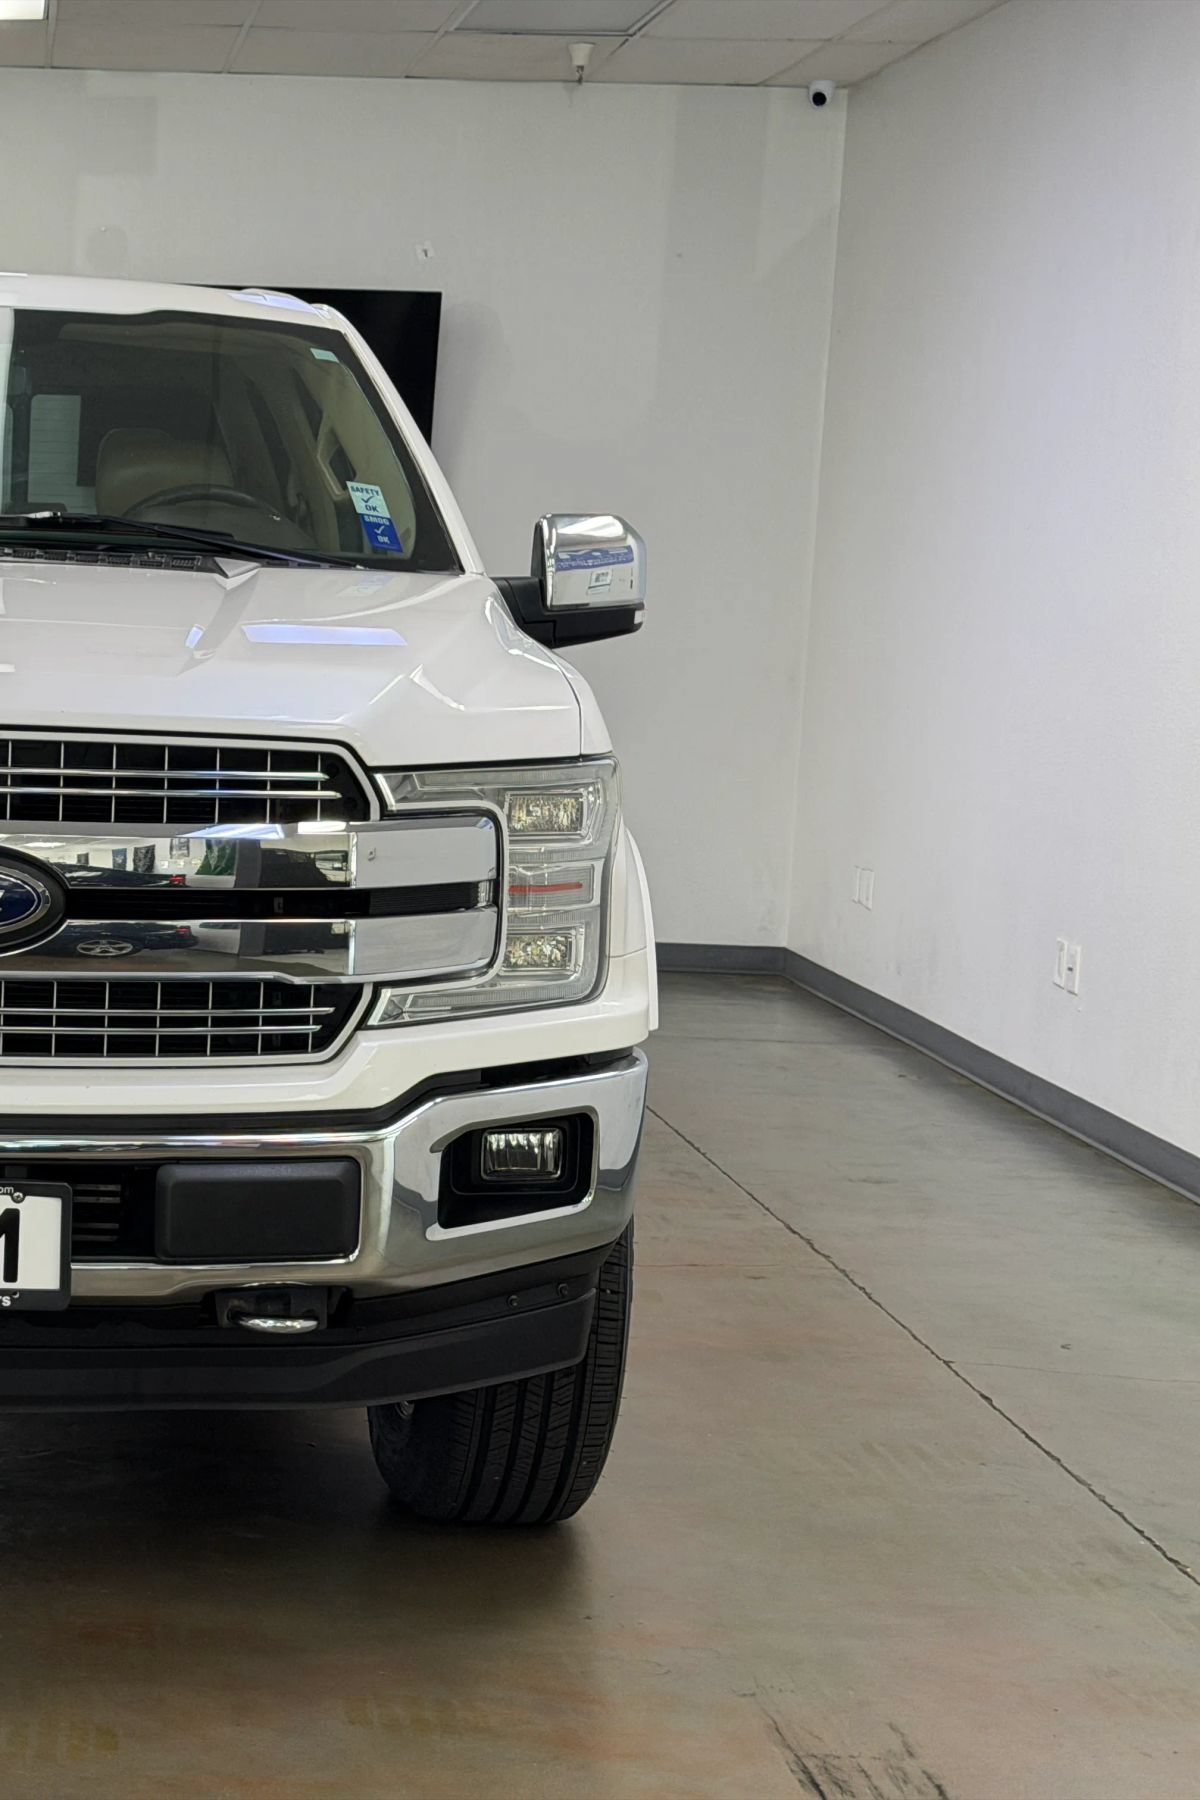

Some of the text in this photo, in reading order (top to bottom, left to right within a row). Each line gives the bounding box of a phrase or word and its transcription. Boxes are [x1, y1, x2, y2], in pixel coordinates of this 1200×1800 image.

[351, 486, 379, 496] SAFETY
[365, 505, 379, 513] OK
[364, 515, 390, 525] SMOG
[377, 535, 390, 544] OK
